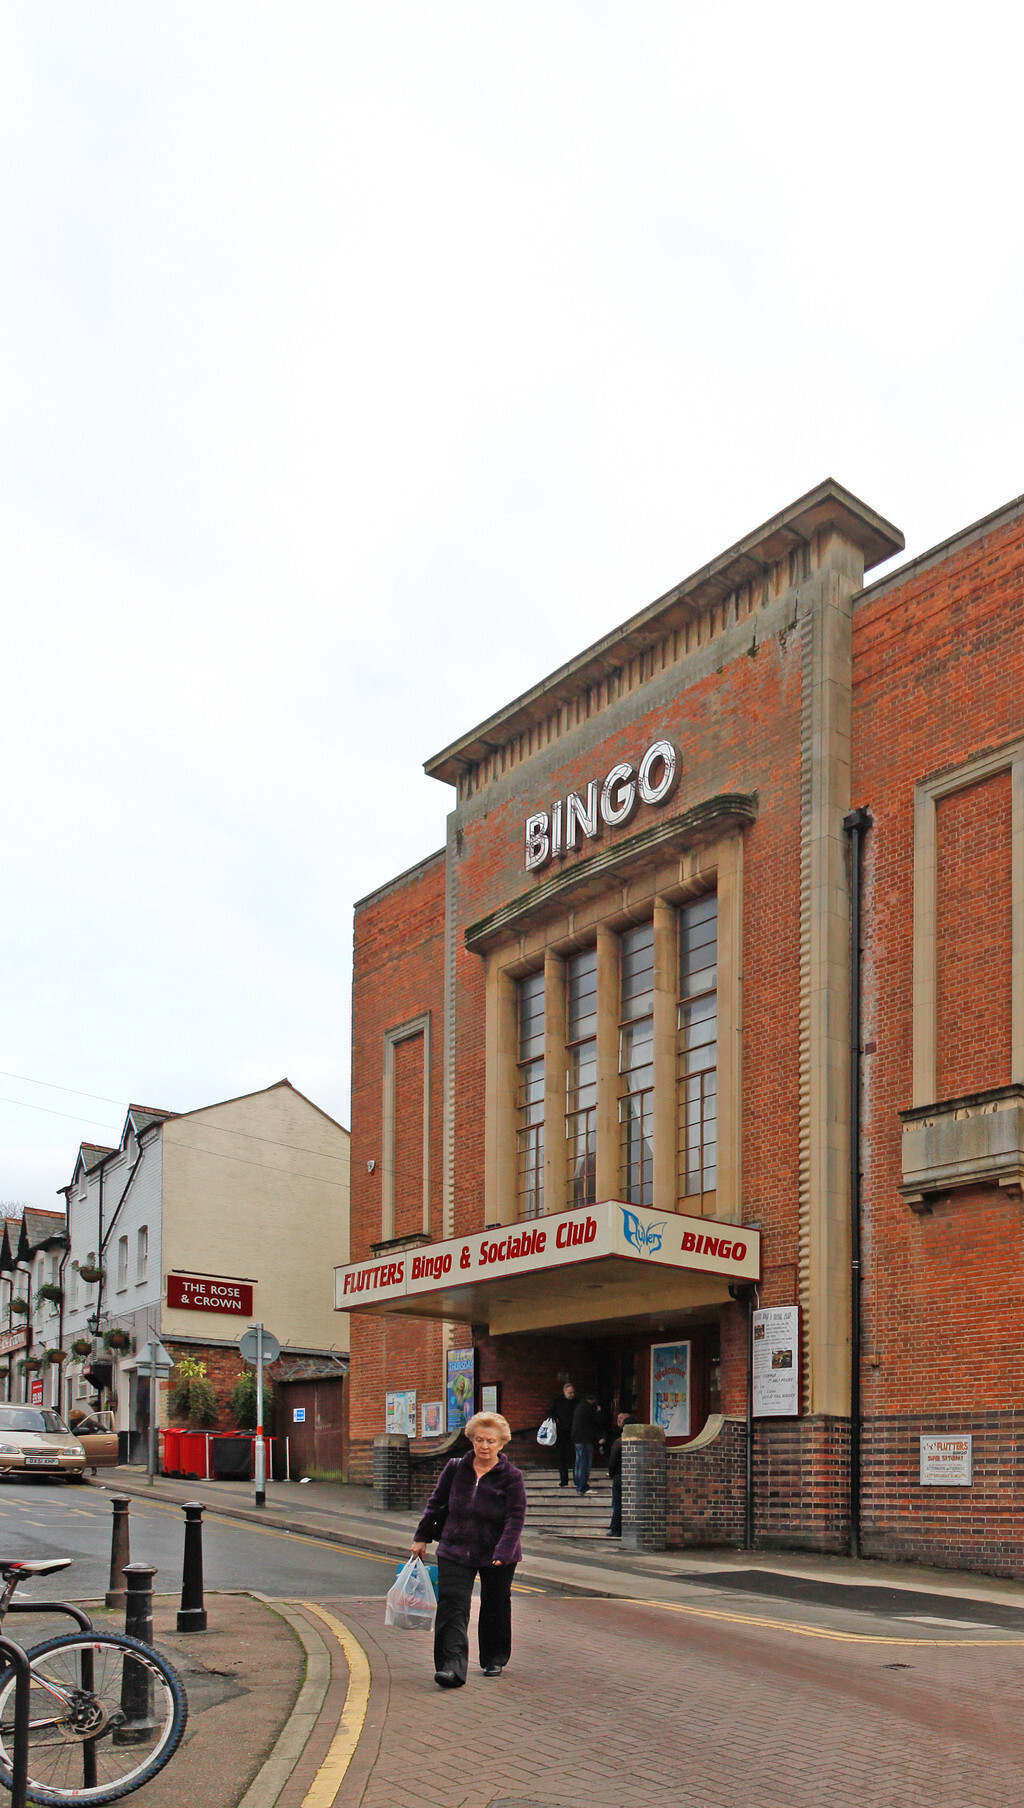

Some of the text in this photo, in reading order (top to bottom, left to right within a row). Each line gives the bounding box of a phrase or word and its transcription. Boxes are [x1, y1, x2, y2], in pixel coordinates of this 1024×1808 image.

[524, 739, 679, 873] BINGO
[680, 1231, 748, 1262] BINGO
[343, 1216, 598, 1295] FLUTTERS Bingo & Sociable Club
[183, 1282, 240, 1297] THE ROSE
[181, 1295, 241, 1309] & CROWN
[655, 1367, 686, 1381] Welcome
[937, 1442, 968, 1450] FLUTTERS
